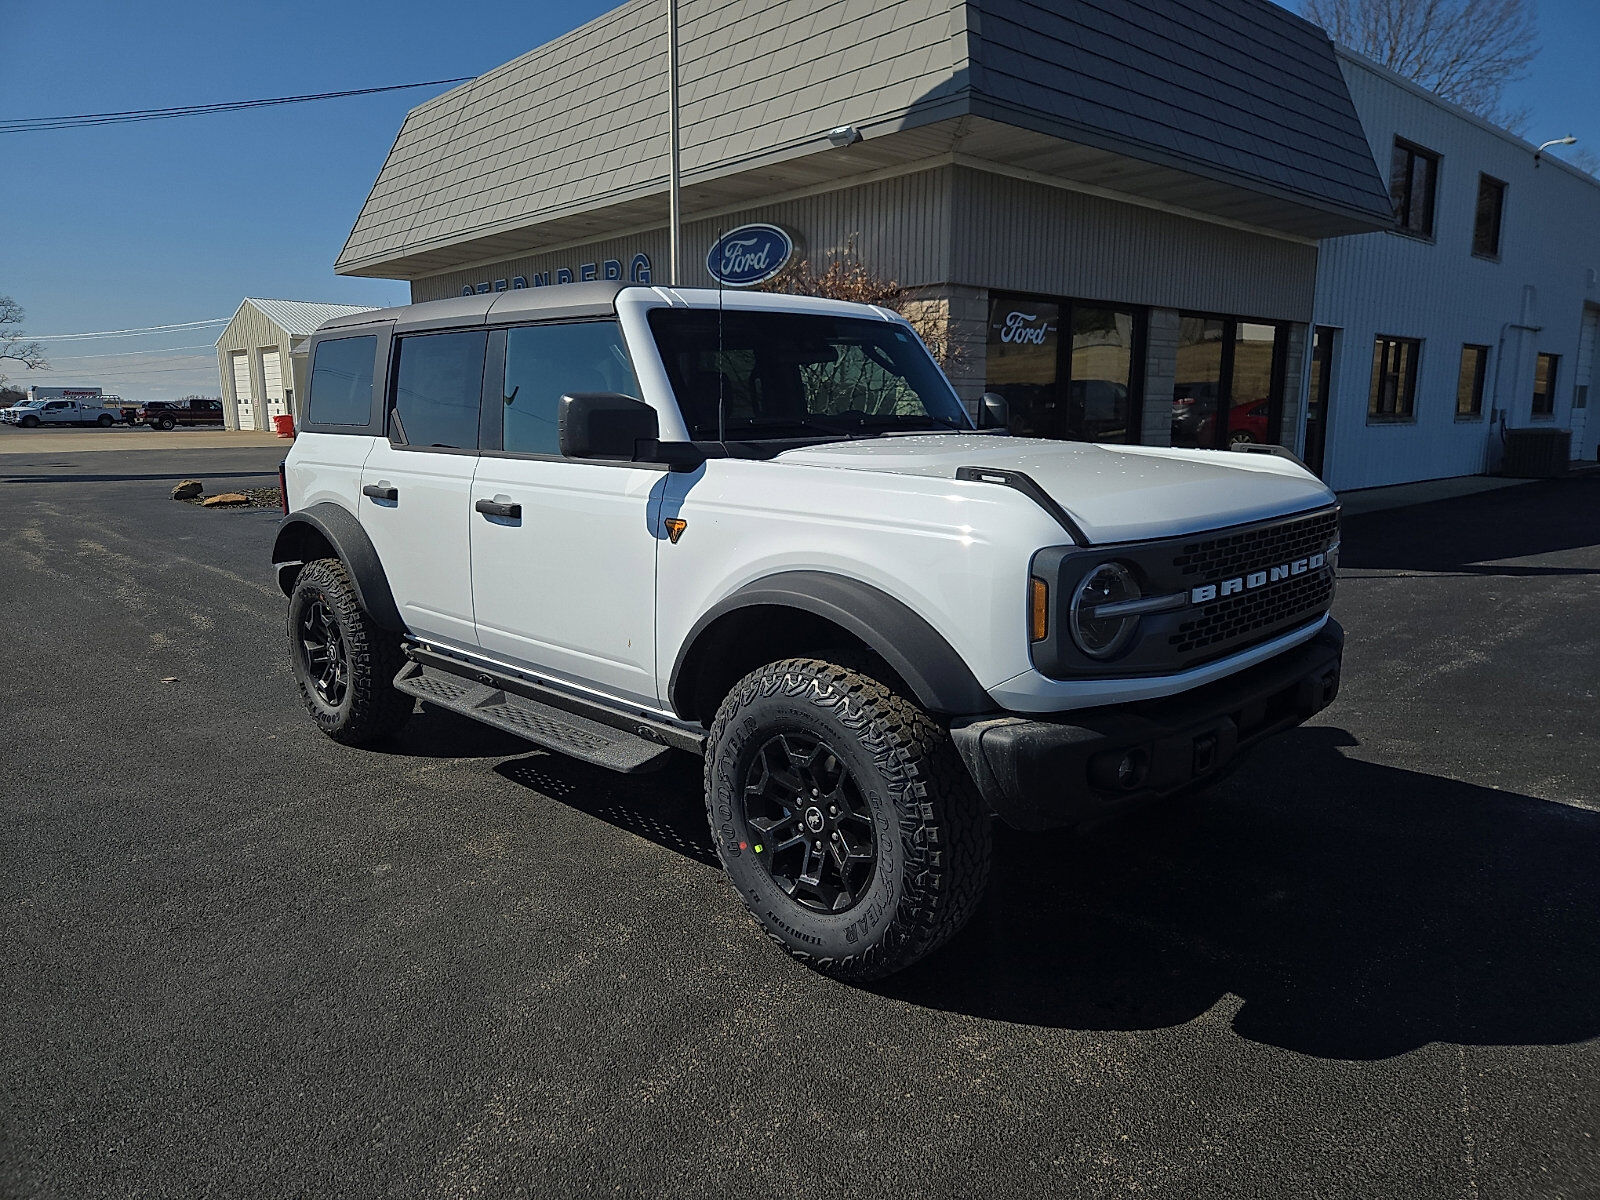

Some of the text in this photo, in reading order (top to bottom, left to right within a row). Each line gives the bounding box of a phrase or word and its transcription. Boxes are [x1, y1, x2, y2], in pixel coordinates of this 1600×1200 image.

[721, 237, 771, 275] Ford
[1001, 311, 1048, 345] Ford
[1191, 553, 1325, 604] BRONCO
[717, 715, 759, 858] GOODYEAR
[843, 789, 894, 944] GOODYEAR
[766, 910, 823, 946] TERRITORY
